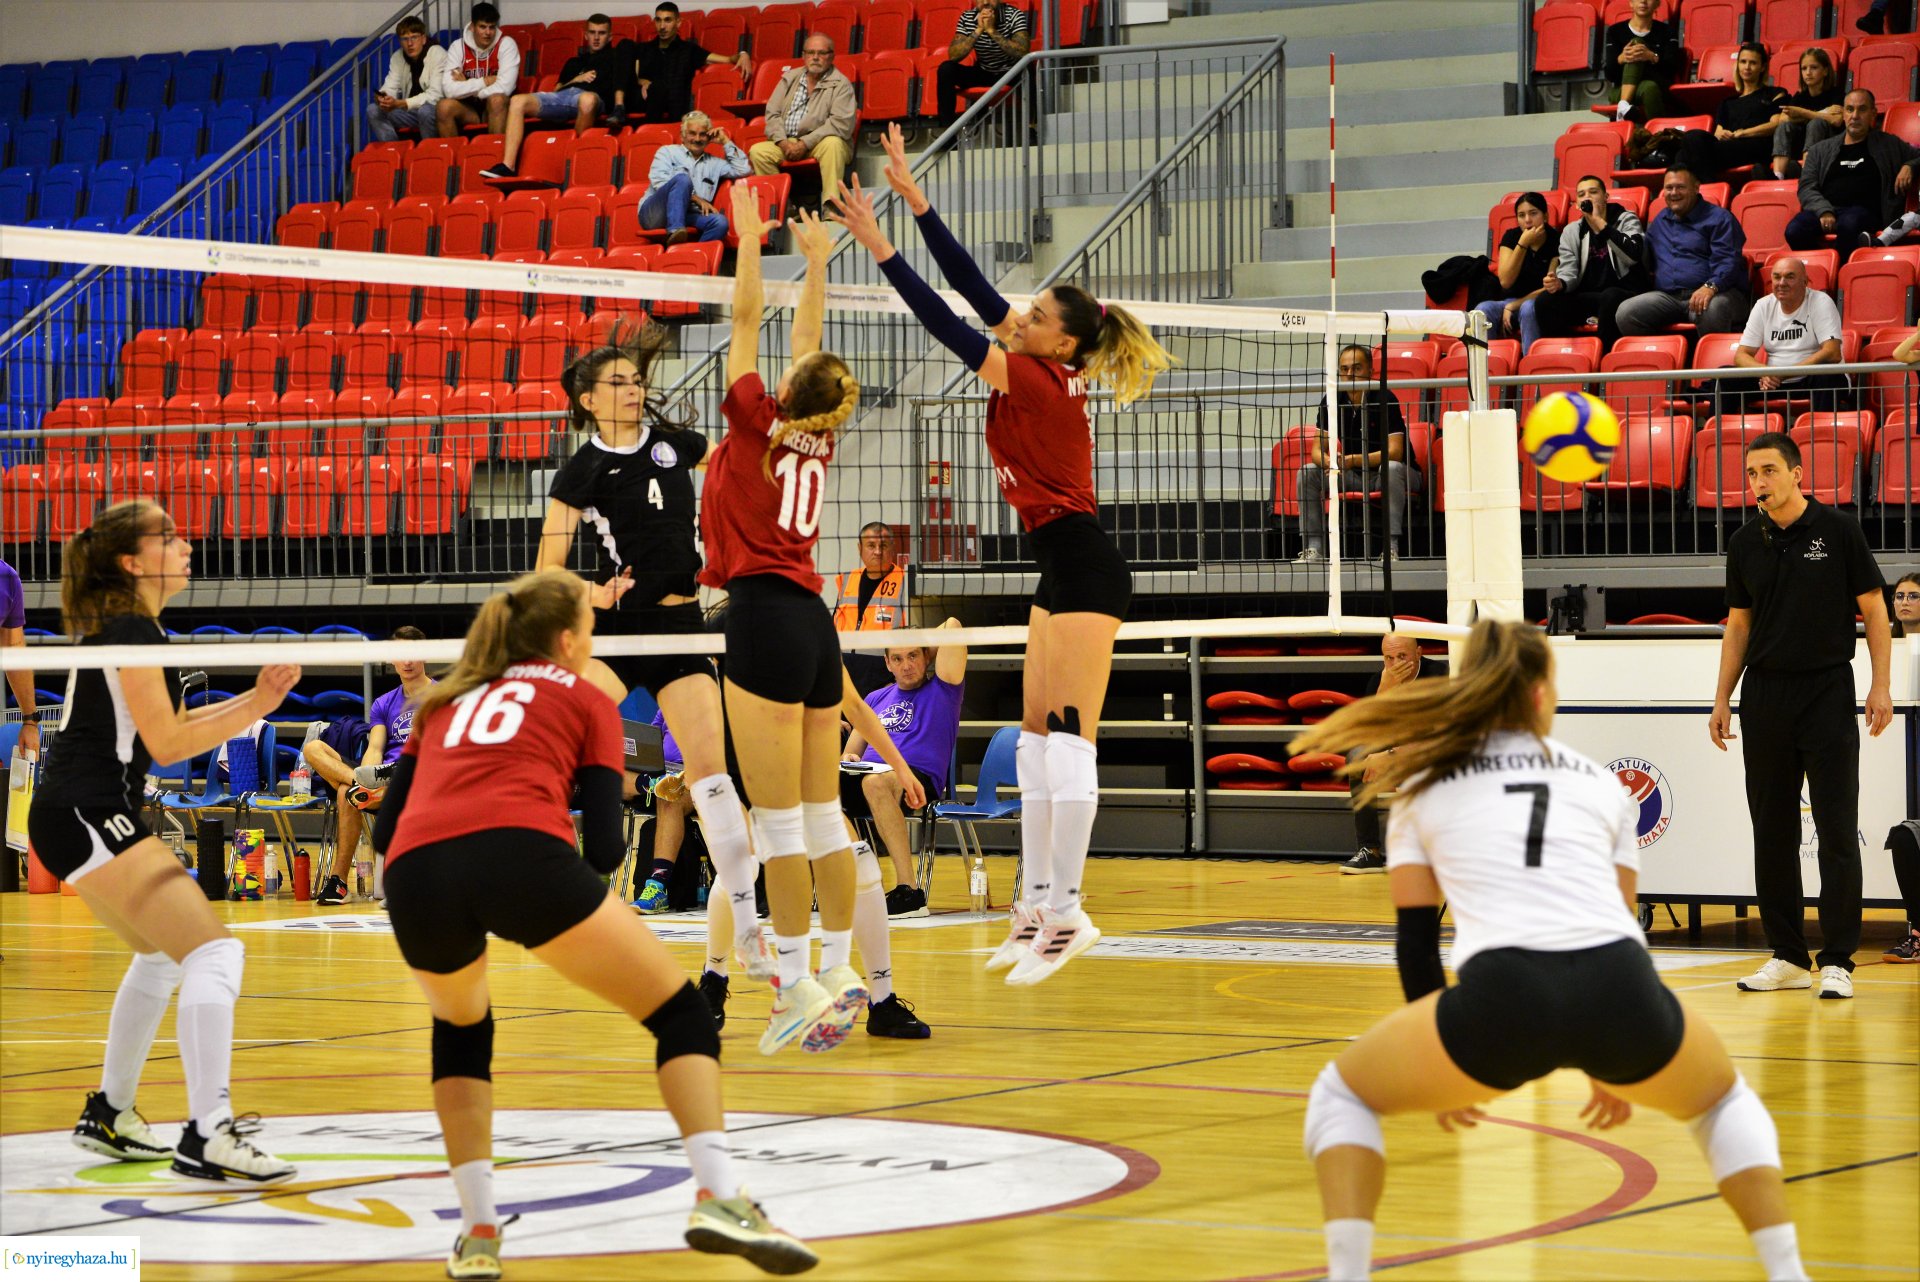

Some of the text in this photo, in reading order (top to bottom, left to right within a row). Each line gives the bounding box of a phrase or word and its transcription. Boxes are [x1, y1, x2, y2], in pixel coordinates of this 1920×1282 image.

[1291, 315, 1306, 326] CEV
[1770, 328, 1803, 341] PUMA
[647, 478, 664, 510] 4
[775, 451, 826, 538] 10
[880, 580, 897, 596] 03
[443, 680, 536, 749] 16
[1609, 758, 1652, 775] FATUM
[103, 814, 136, 842] 10
[1503, 783, 1550, 868] 7
